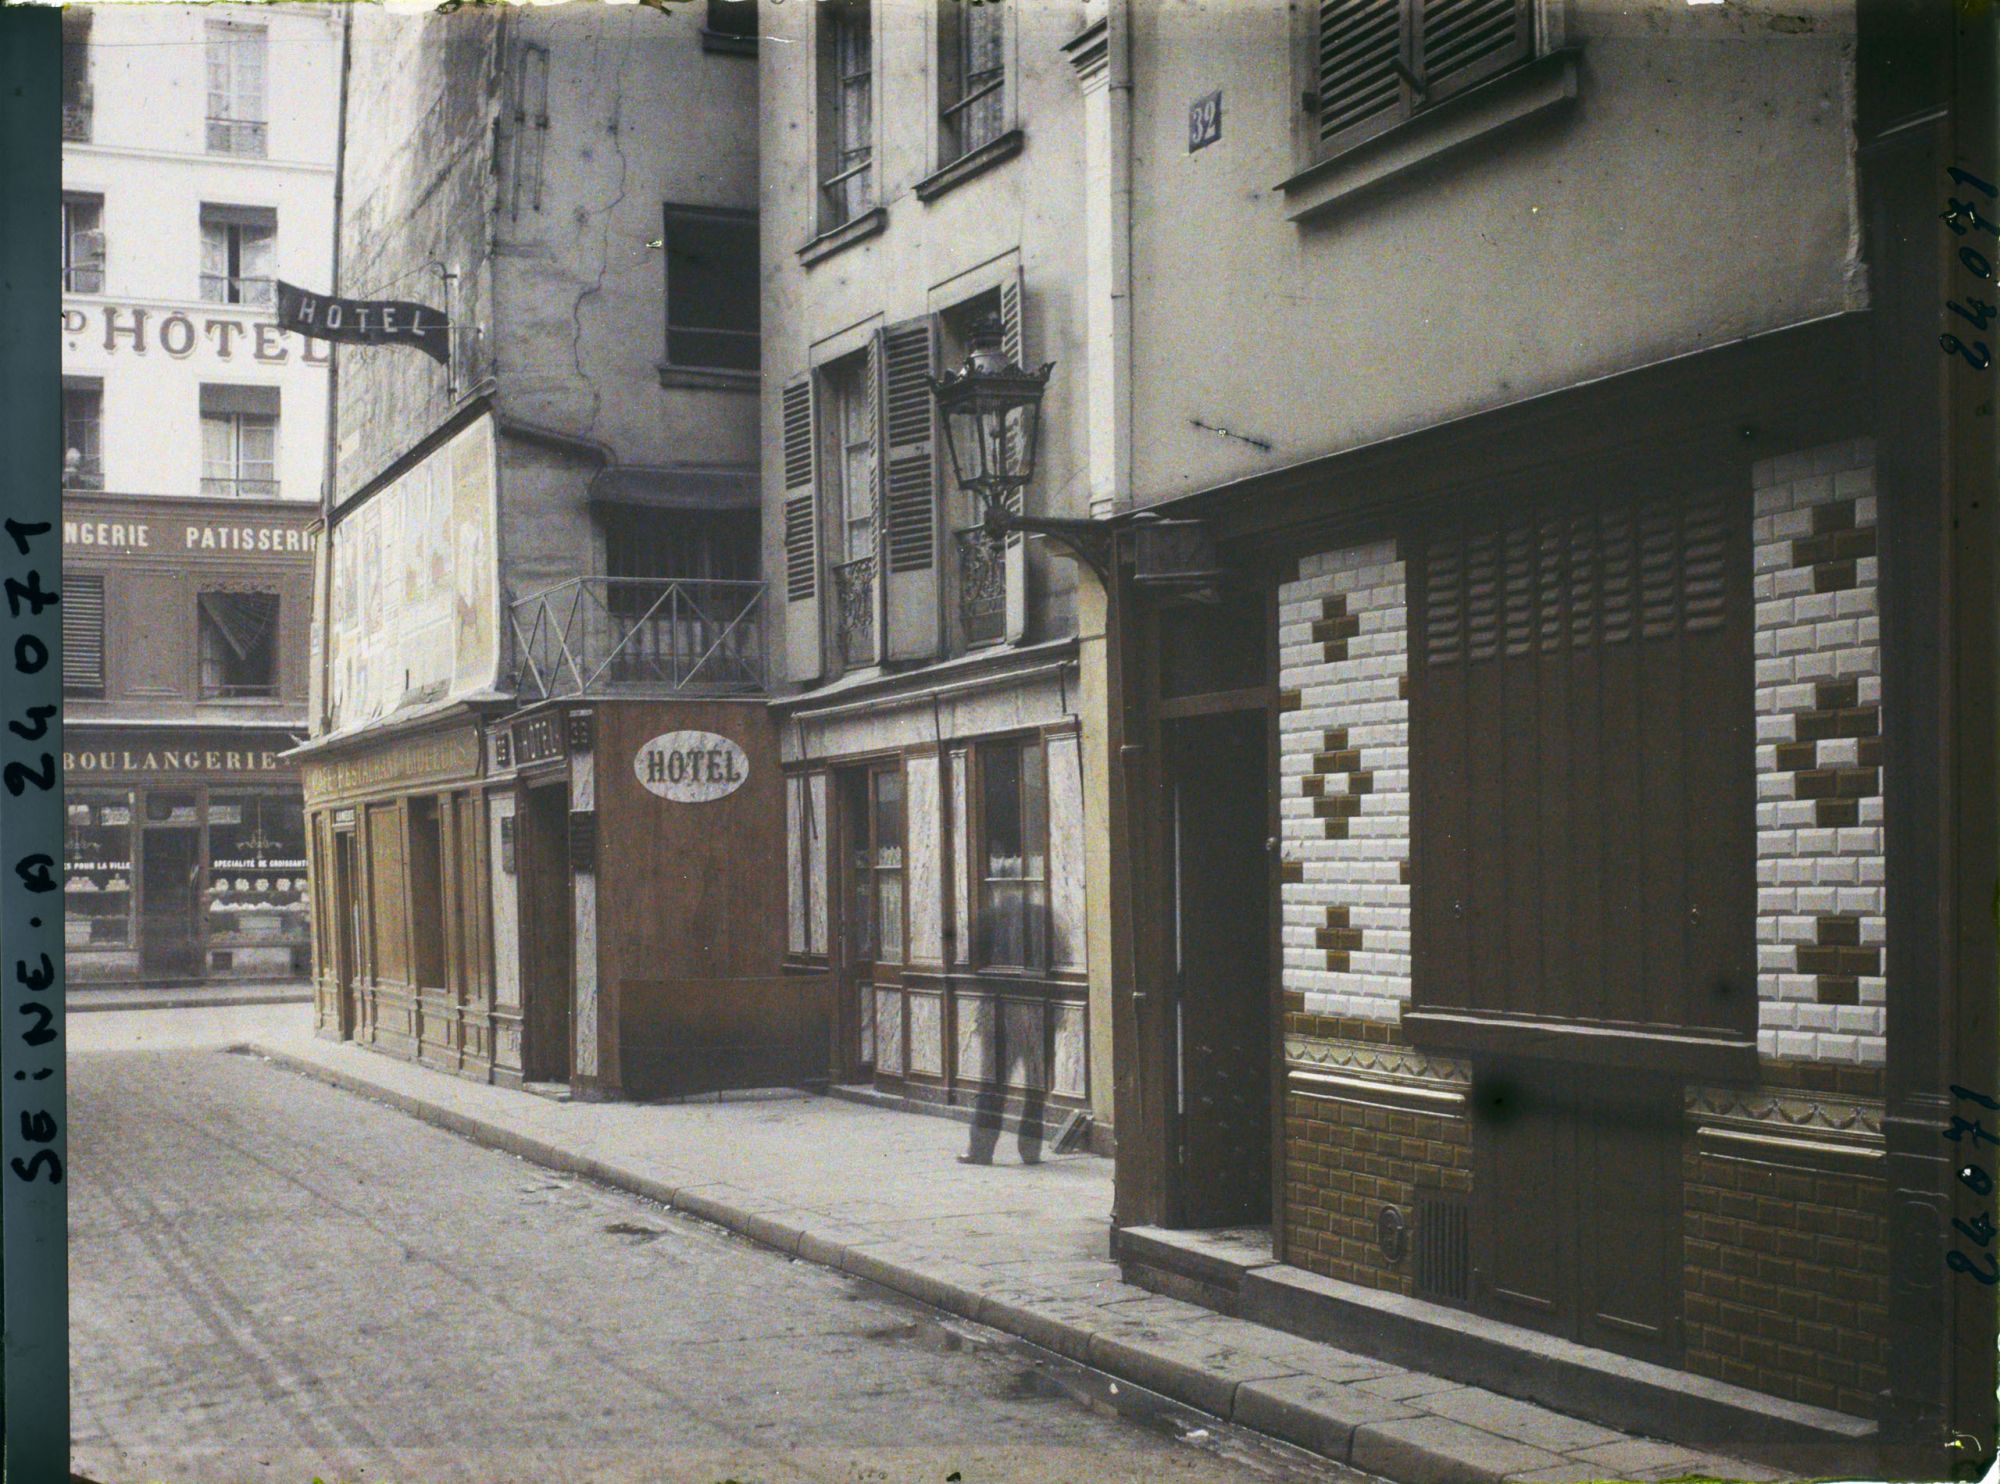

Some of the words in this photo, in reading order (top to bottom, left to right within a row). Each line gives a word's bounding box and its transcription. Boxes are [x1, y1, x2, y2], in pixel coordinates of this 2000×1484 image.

[298, 296, 426, 337] HOTEL
[3, 517, 60, 797] 24071
[97, 861, 107, 871] LA
